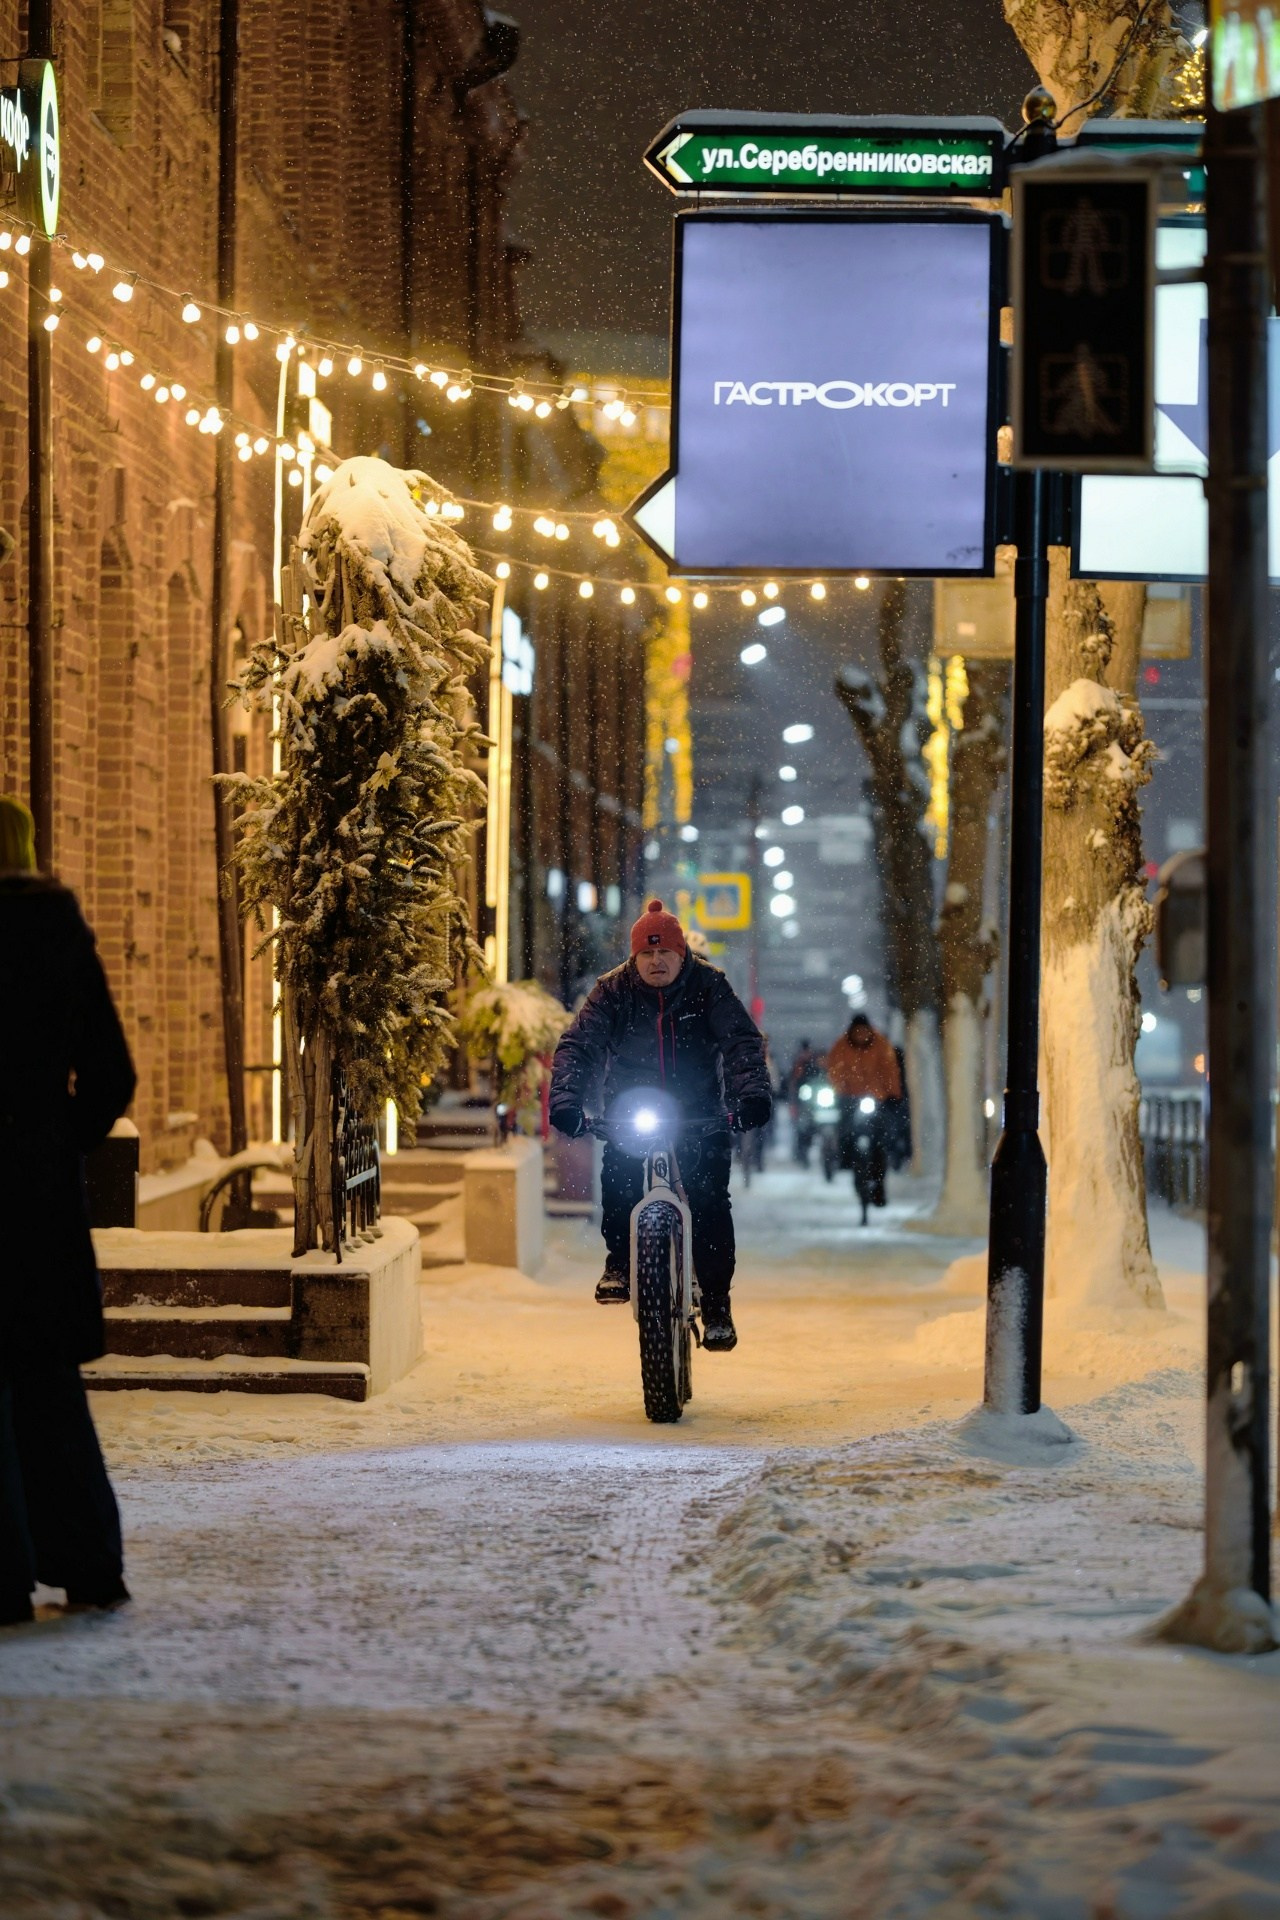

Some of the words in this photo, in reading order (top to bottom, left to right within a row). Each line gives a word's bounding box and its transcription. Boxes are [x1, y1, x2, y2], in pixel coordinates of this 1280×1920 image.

[0, 88, 30, 174] кофе
[702, 143, 993, 177] ул.Серебренниковская
[713, 380, 957, 410] ГАСТРОКОРТ
